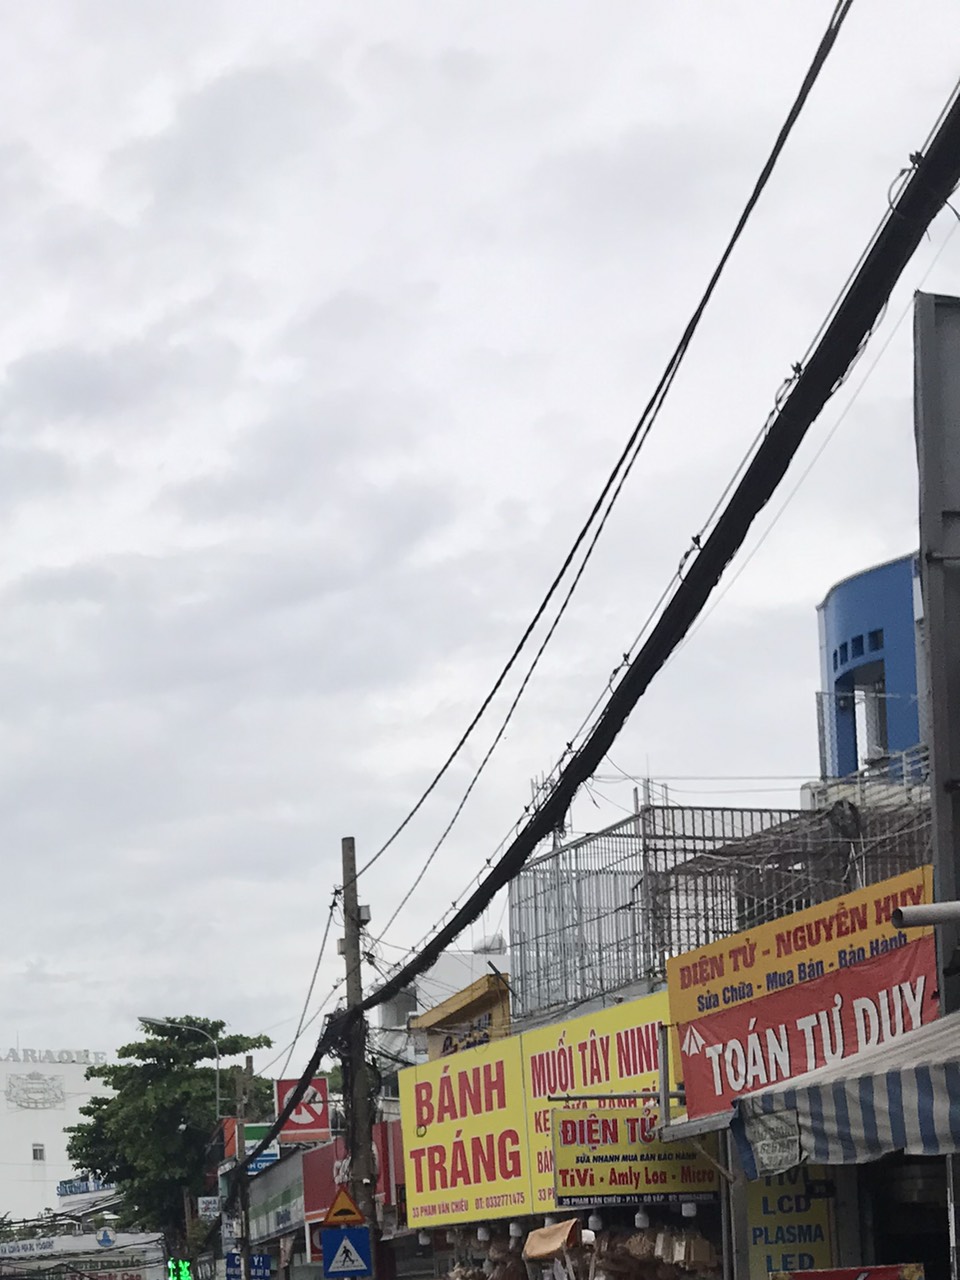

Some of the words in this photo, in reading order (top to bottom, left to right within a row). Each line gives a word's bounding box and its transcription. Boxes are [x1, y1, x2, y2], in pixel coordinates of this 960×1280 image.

[679, 952, 725, 990] ĐIỆN
[729, 938, 757, 972] TỬ
[775, 902, 868, 959] NGUYỄN
[697, 988, 719, 1013] Sửa
[722, 980, 754, 1005] Chữa
[766, 967, 794, 992] Mua
[797, 959, 824, 983] Bán
[705, 1017, 790, 1096] TOÁN
[796, 993, 844, 1072] TƯ
[853, 976, 926, 1053] DUY
[530, 1030, 575, 1098] MUỐI
[578, 1029, 610, 1087] TÂY
[415, 1060, 506, 1128] BÁNH
[560, 1113, 619, 1150] ĐIỆN
[625, 1109, 658, 1143] TỬ
[410, 1129, 522, 1193] TRÁNG
[559, 1168, 595, 1187] TiVi
[609, 1166, 640, 1190] Amly
[645, 1167, 668, 1185] Loa
[681, 1166, 715, 1184] Micro
[762, 1195, 811, 1216] LCD
[752, 1224, 825, 1246] PLASMA
[766, 1252, 814, 1272] LED
